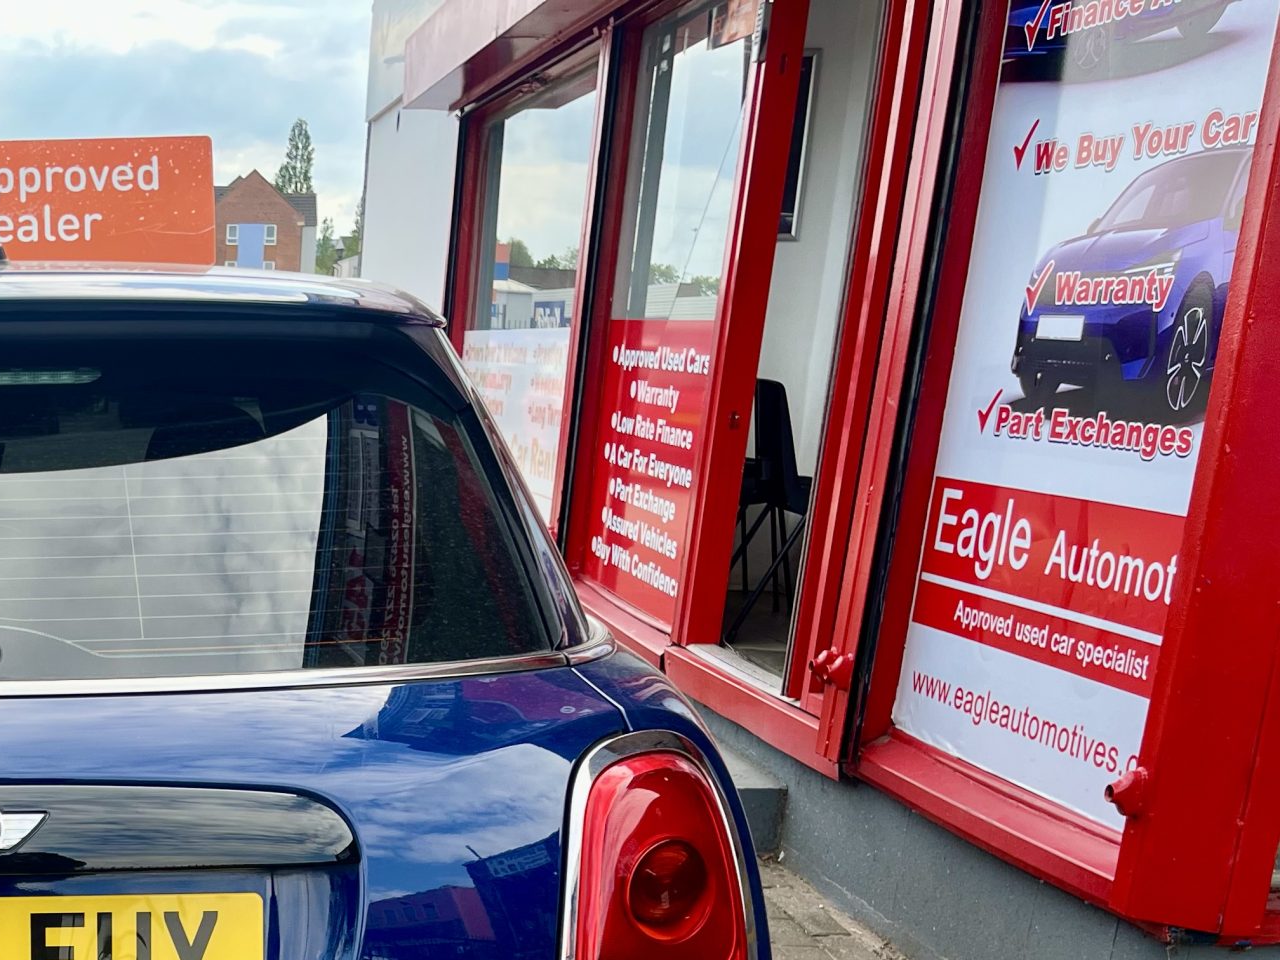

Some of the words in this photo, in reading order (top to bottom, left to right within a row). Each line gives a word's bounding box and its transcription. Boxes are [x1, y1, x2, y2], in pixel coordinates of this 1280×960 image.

[1047, 0, 1145, 40] Finance
[1035, 139, 1070, 174] We
[1075, 132, 1125, 171] Buy
[1132, 122, 1195, 160] Your
[1201, 108, 1257, 148] Car
[1055, 270, 1175, 311] Warranty
[618, 344, 661, 371] Approved
[661, 346, 686, 372] Used
[687, 347, 710, 375] Cars
[637, 379, 680, 414] Warranty
[616, 411, 635, 435] Low
[634, 414, 655, 440] Rate
[655, 418, 693, 449] Finance
[993, 404, 1044, 440] Part
[1048, 408, 1194, 460] Exchanges
[609, 443, 616, 464] A
[618, 444, 632, 468] Car
[632, 449, 648, 473] For
[648, 453, 692, 488] Everyone
[615, 478, 632, 504] Part
[633, 484, 676, 523] Exchange
[595, 535, 611, 566] Buy
[611, 543, 631, 573] With
[606, 508, 640, 541] Assured
[640, 521, 677, 559] Vehicles
[934, 488, 1032, 580] Eagle
[1044, 530, 1178, 604] Automot
[953, 600, 1014, 637] Approved
[1015, 622, 1049, 648] used
[1051, 632, 1075, 656] car
[1075, 641, 1150, 680] specialist
